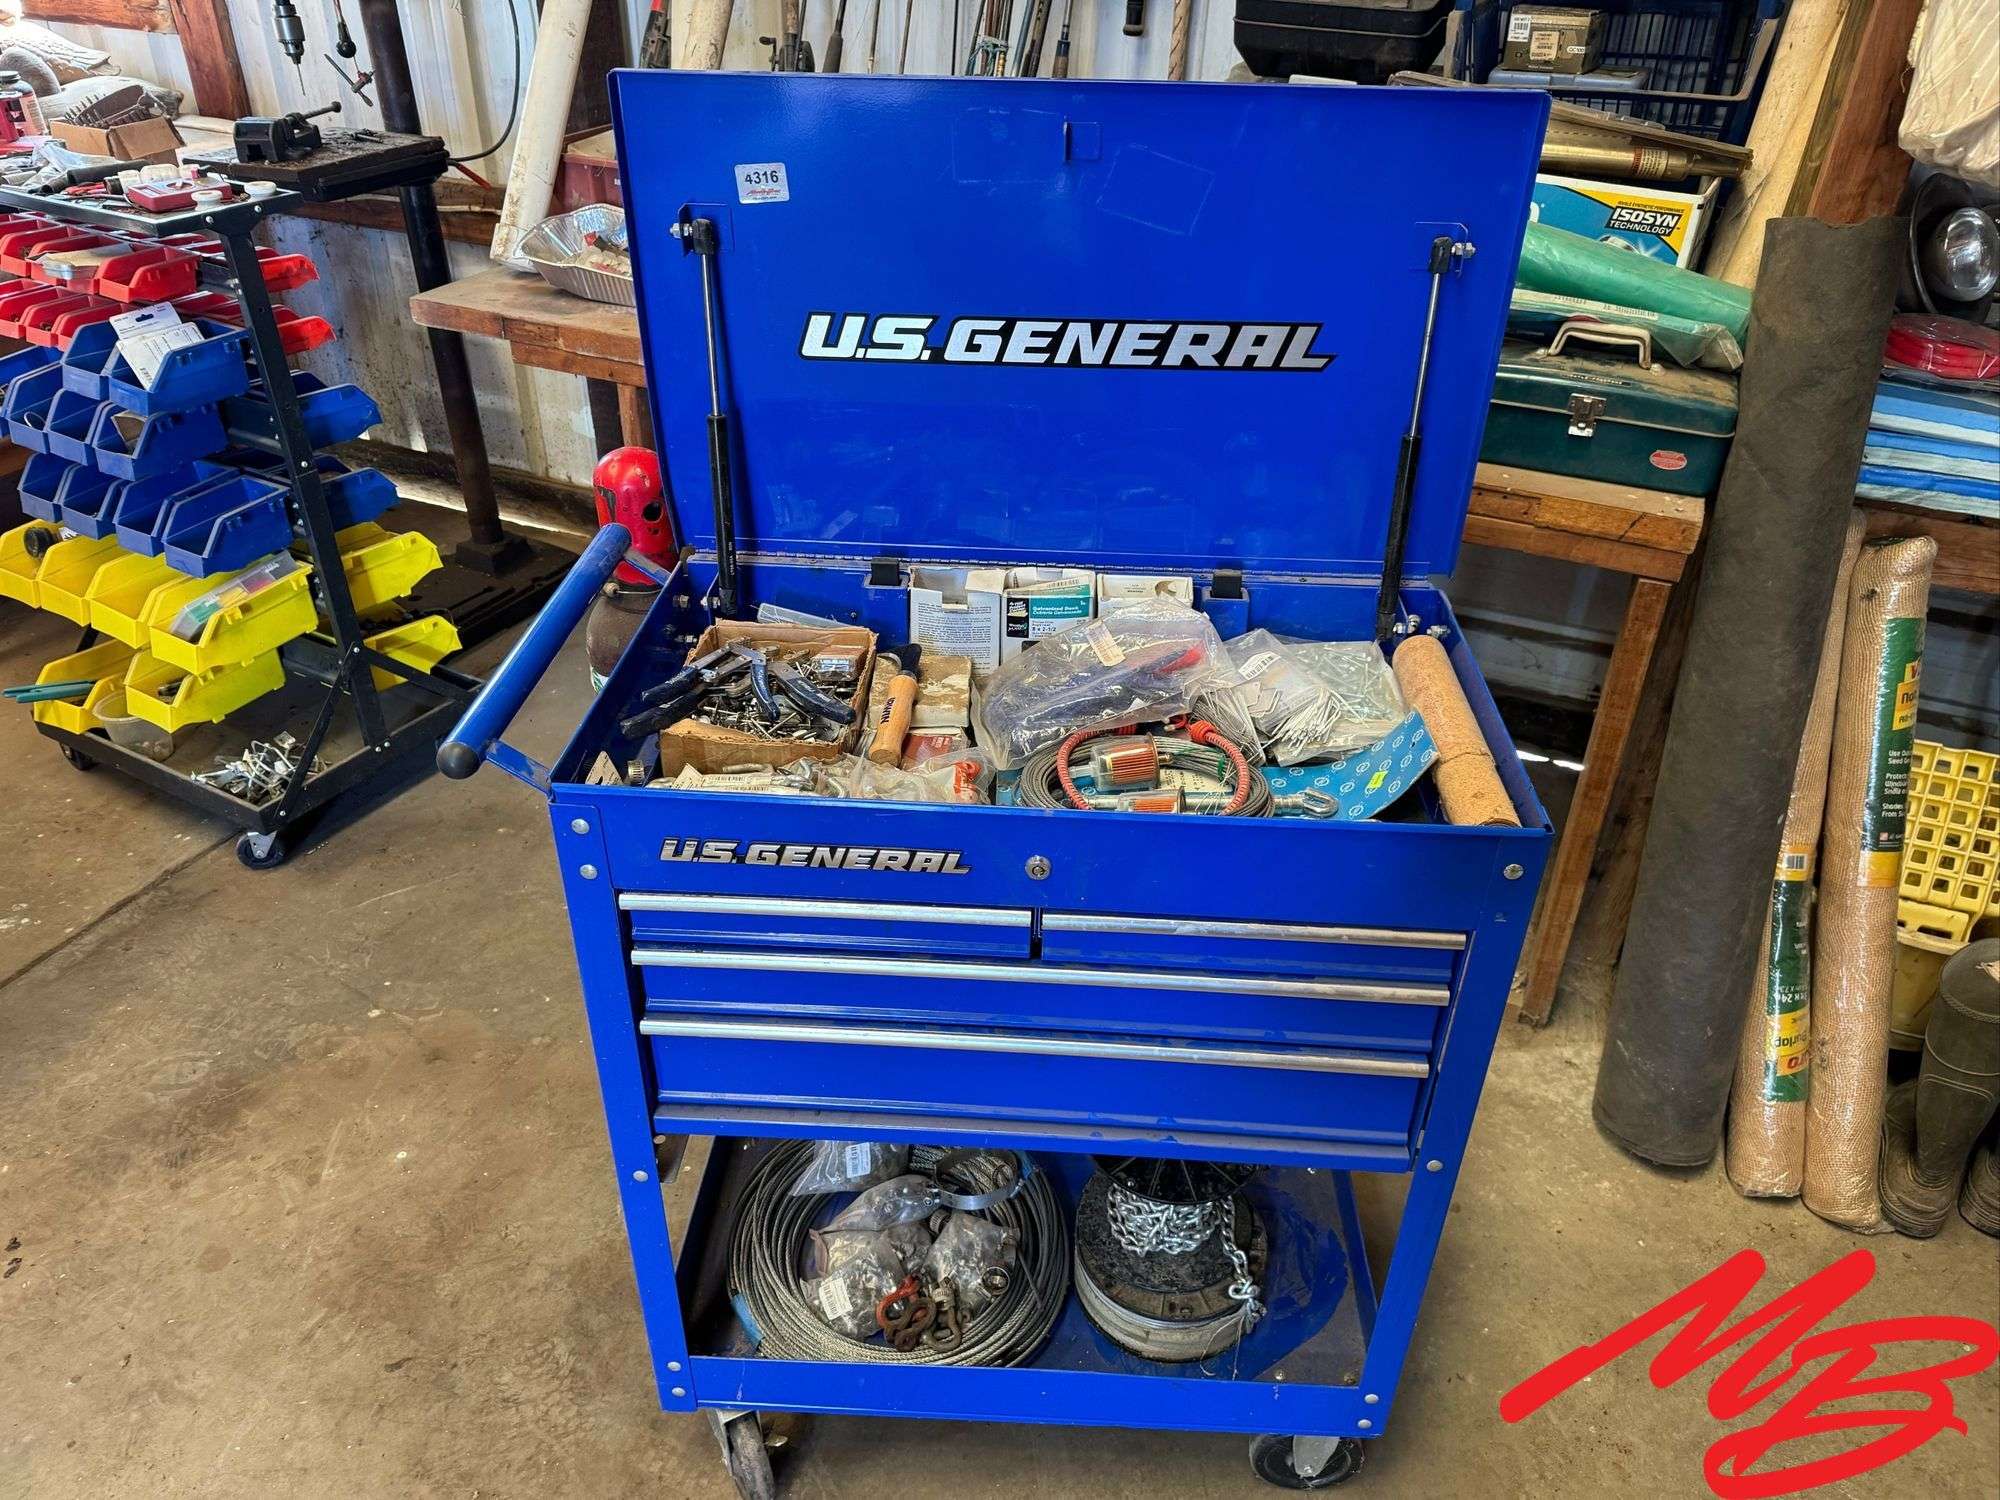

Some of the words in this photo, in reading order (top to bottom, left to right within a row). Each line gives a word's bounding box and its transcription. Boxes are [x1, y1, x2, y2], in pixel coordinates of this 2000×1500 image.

[745, 170, 779, 185] 4316
[1612, 208, 1679, 227] ISOSYN
[1609, 221, 1673, 235] TECHNOLOGY
[880, 697, 896, 725] IRWIN
